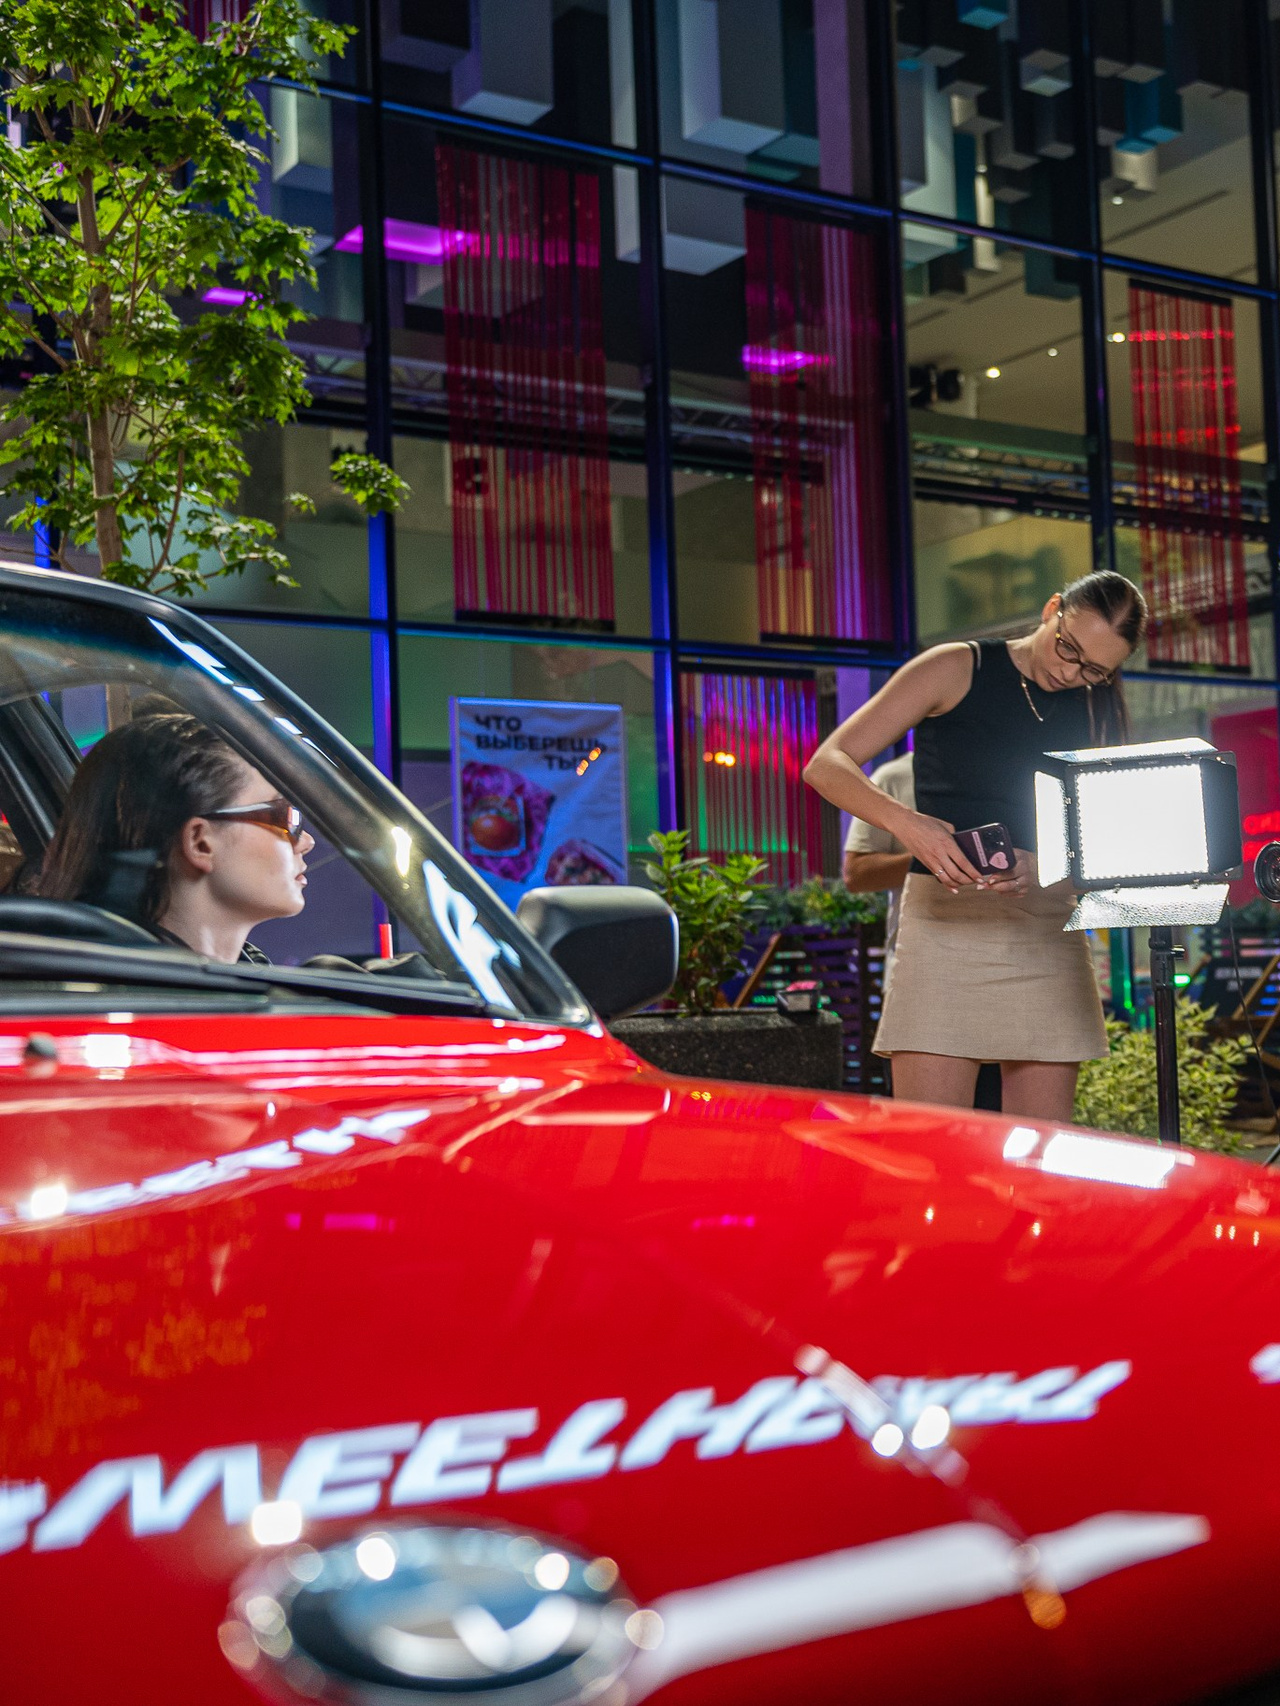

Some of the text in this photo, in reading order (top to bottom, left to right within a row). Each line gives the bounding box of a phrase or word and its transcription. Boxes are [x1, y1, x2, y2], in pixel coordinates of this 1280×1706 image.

[475, 715, 522, 731] ЧТО
[476, 735, 607, 752] ВЫБЕРЕШЬ
[544, 754, 588, 771] ТЫ
